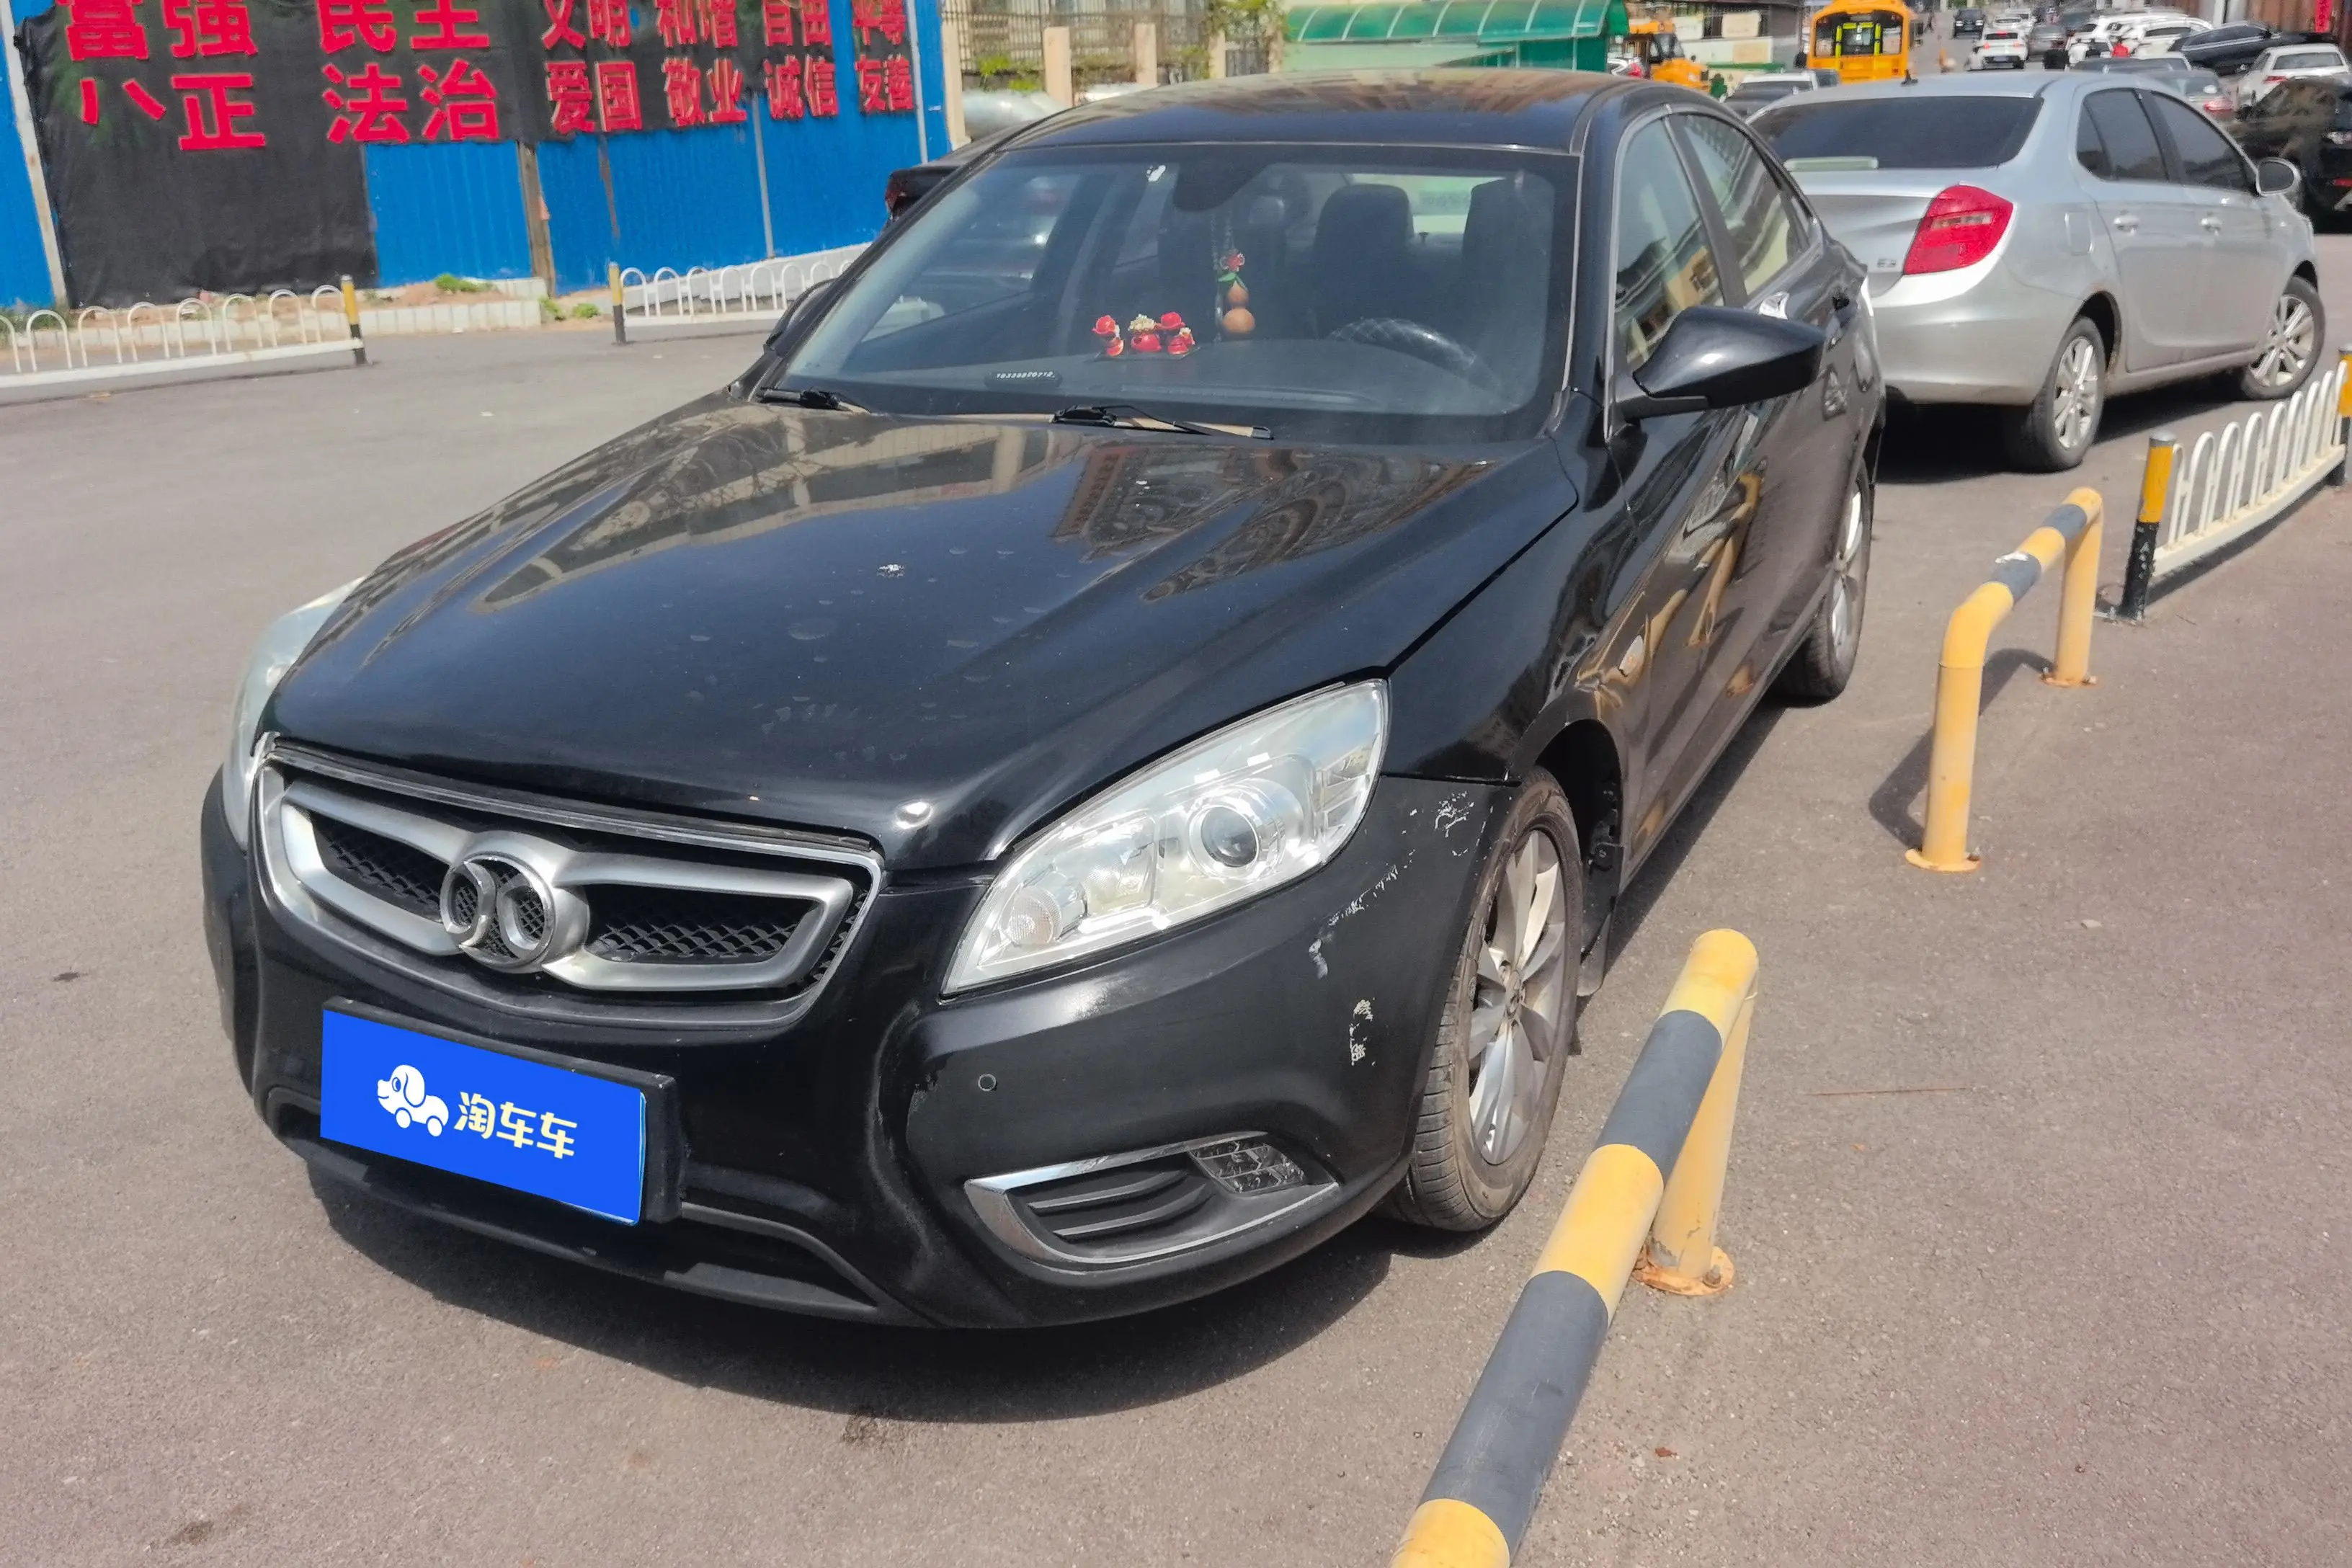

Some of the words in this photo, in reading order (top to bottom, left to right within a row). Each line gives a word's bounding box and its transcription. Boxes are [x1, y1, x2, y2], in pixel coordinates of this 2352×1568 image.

[57, 0, 257, 61] 富强
[316, 0, 490, 54] 民主
[543, 0, 631, 49] 文明
[654, 0, 738, 48] 和谐
[762, 0, 832, 46] 自由
[850, 0, 906, 45] 平等
[322, 58, 499, 144] 法治
[545, 61, 642, 134] 爱国
[662, 58, 747, 127] 敬业
[763, 54, 838, 118] 诚信
[855, 54, 914, 111] 友善
